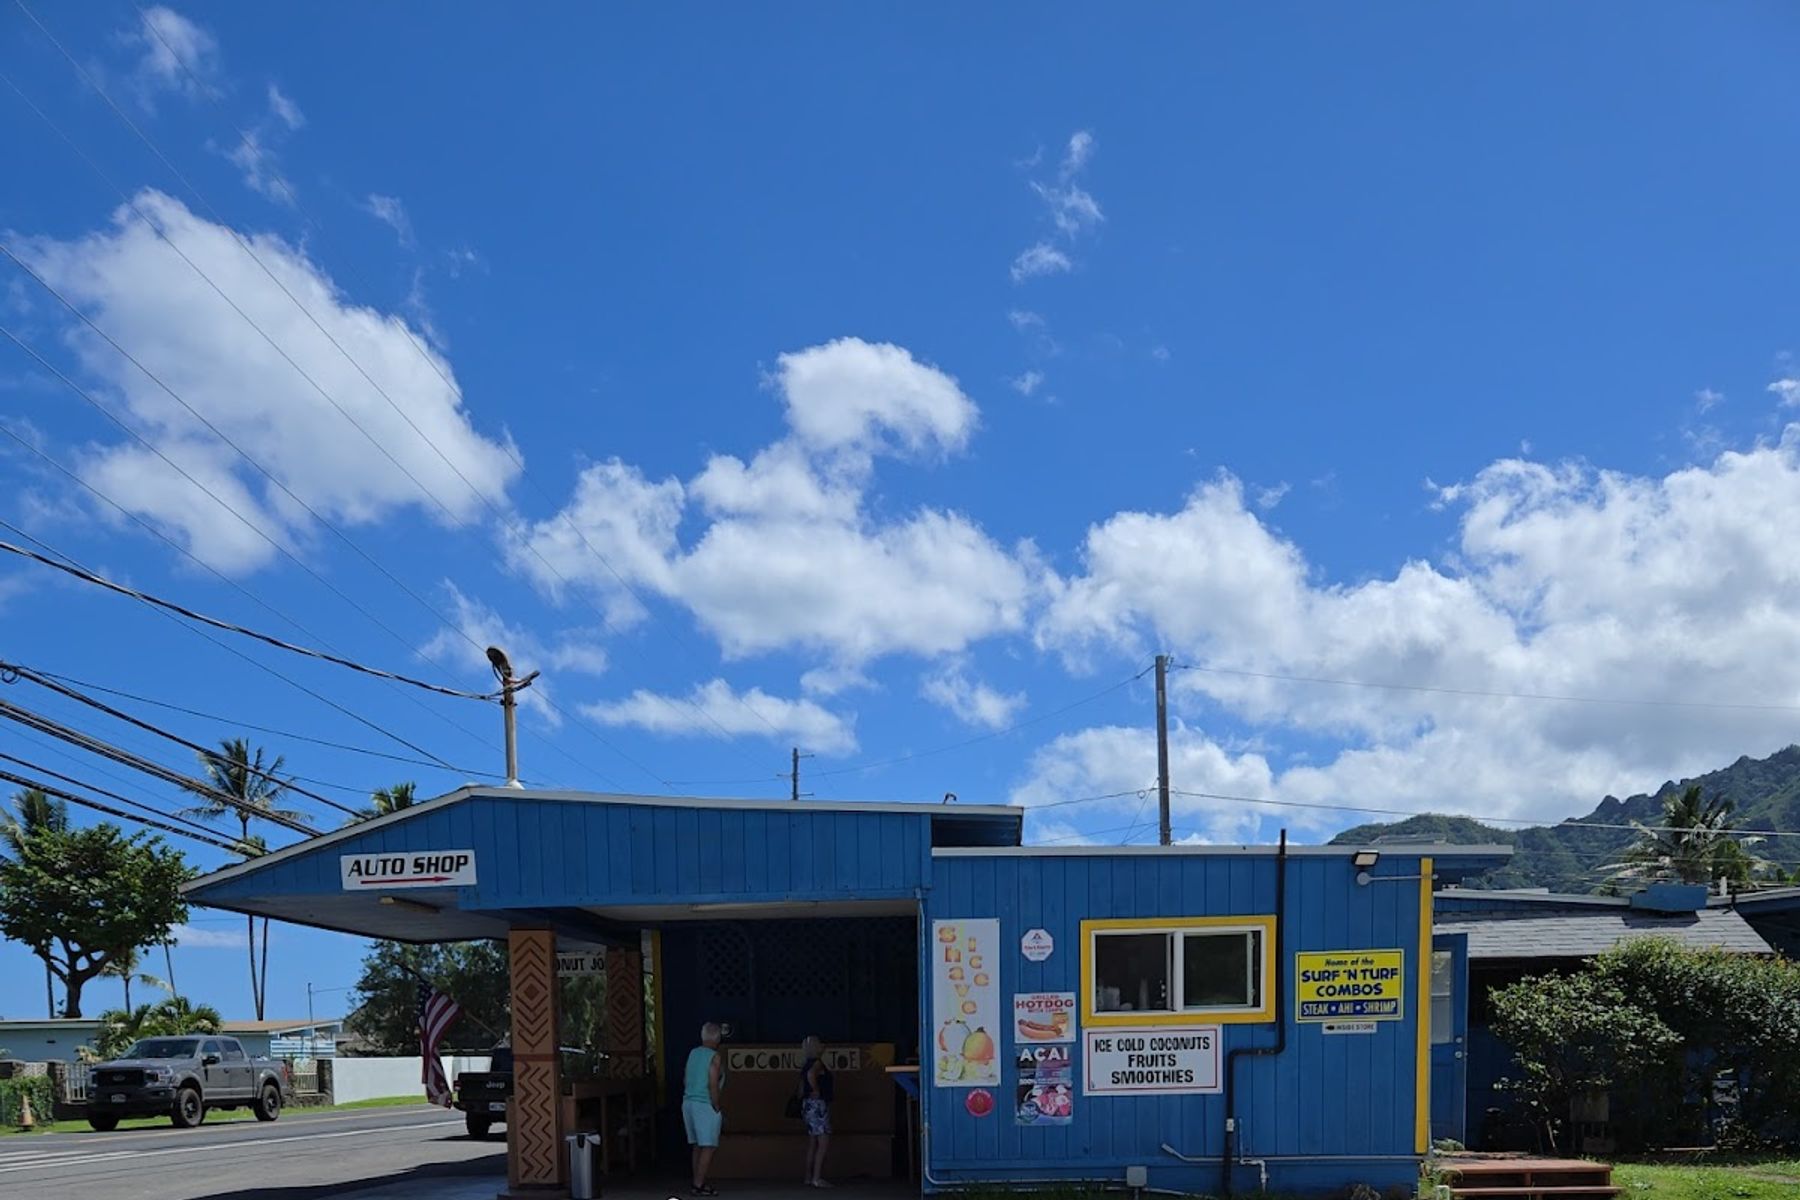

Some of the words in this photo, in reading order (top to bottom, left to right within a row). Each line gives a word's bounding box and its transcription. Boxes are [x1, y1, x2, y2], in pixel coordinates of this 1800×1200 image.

[347, 857, 405, 877] AUTO
[412, 854, 469, 874] SHOP
[1350, 957, 1360, 965] of
[1361, 956, 1375, 965] the
[1301, 969, 1340, 982] SURF
[1360, 967, 1399, 980] TURF
[1316, 983, 1384, 997] COMBOS
[1015, 999, 1074, 1009] HOTDOG
[1303, 1003, 1329, 1016] STEAK
[1338, 1002, 1354, 1014] AHI
[1362, 1000, 1397, 1014] SHRIMP
[1094, 1039, 1112, 1052] ICE
[1117, 1038, 1145, 1052] COLD
[1149, 1036, 1210, 1051] COCONUTS
[830, 1050, 858, 1070] JOE
[1020, 1047, 1069, 1062] ACAI
[1127, 1053, 1177, 1068] FRUITS
[1111, 1069, 1194, 1085] SMOOTHIES
